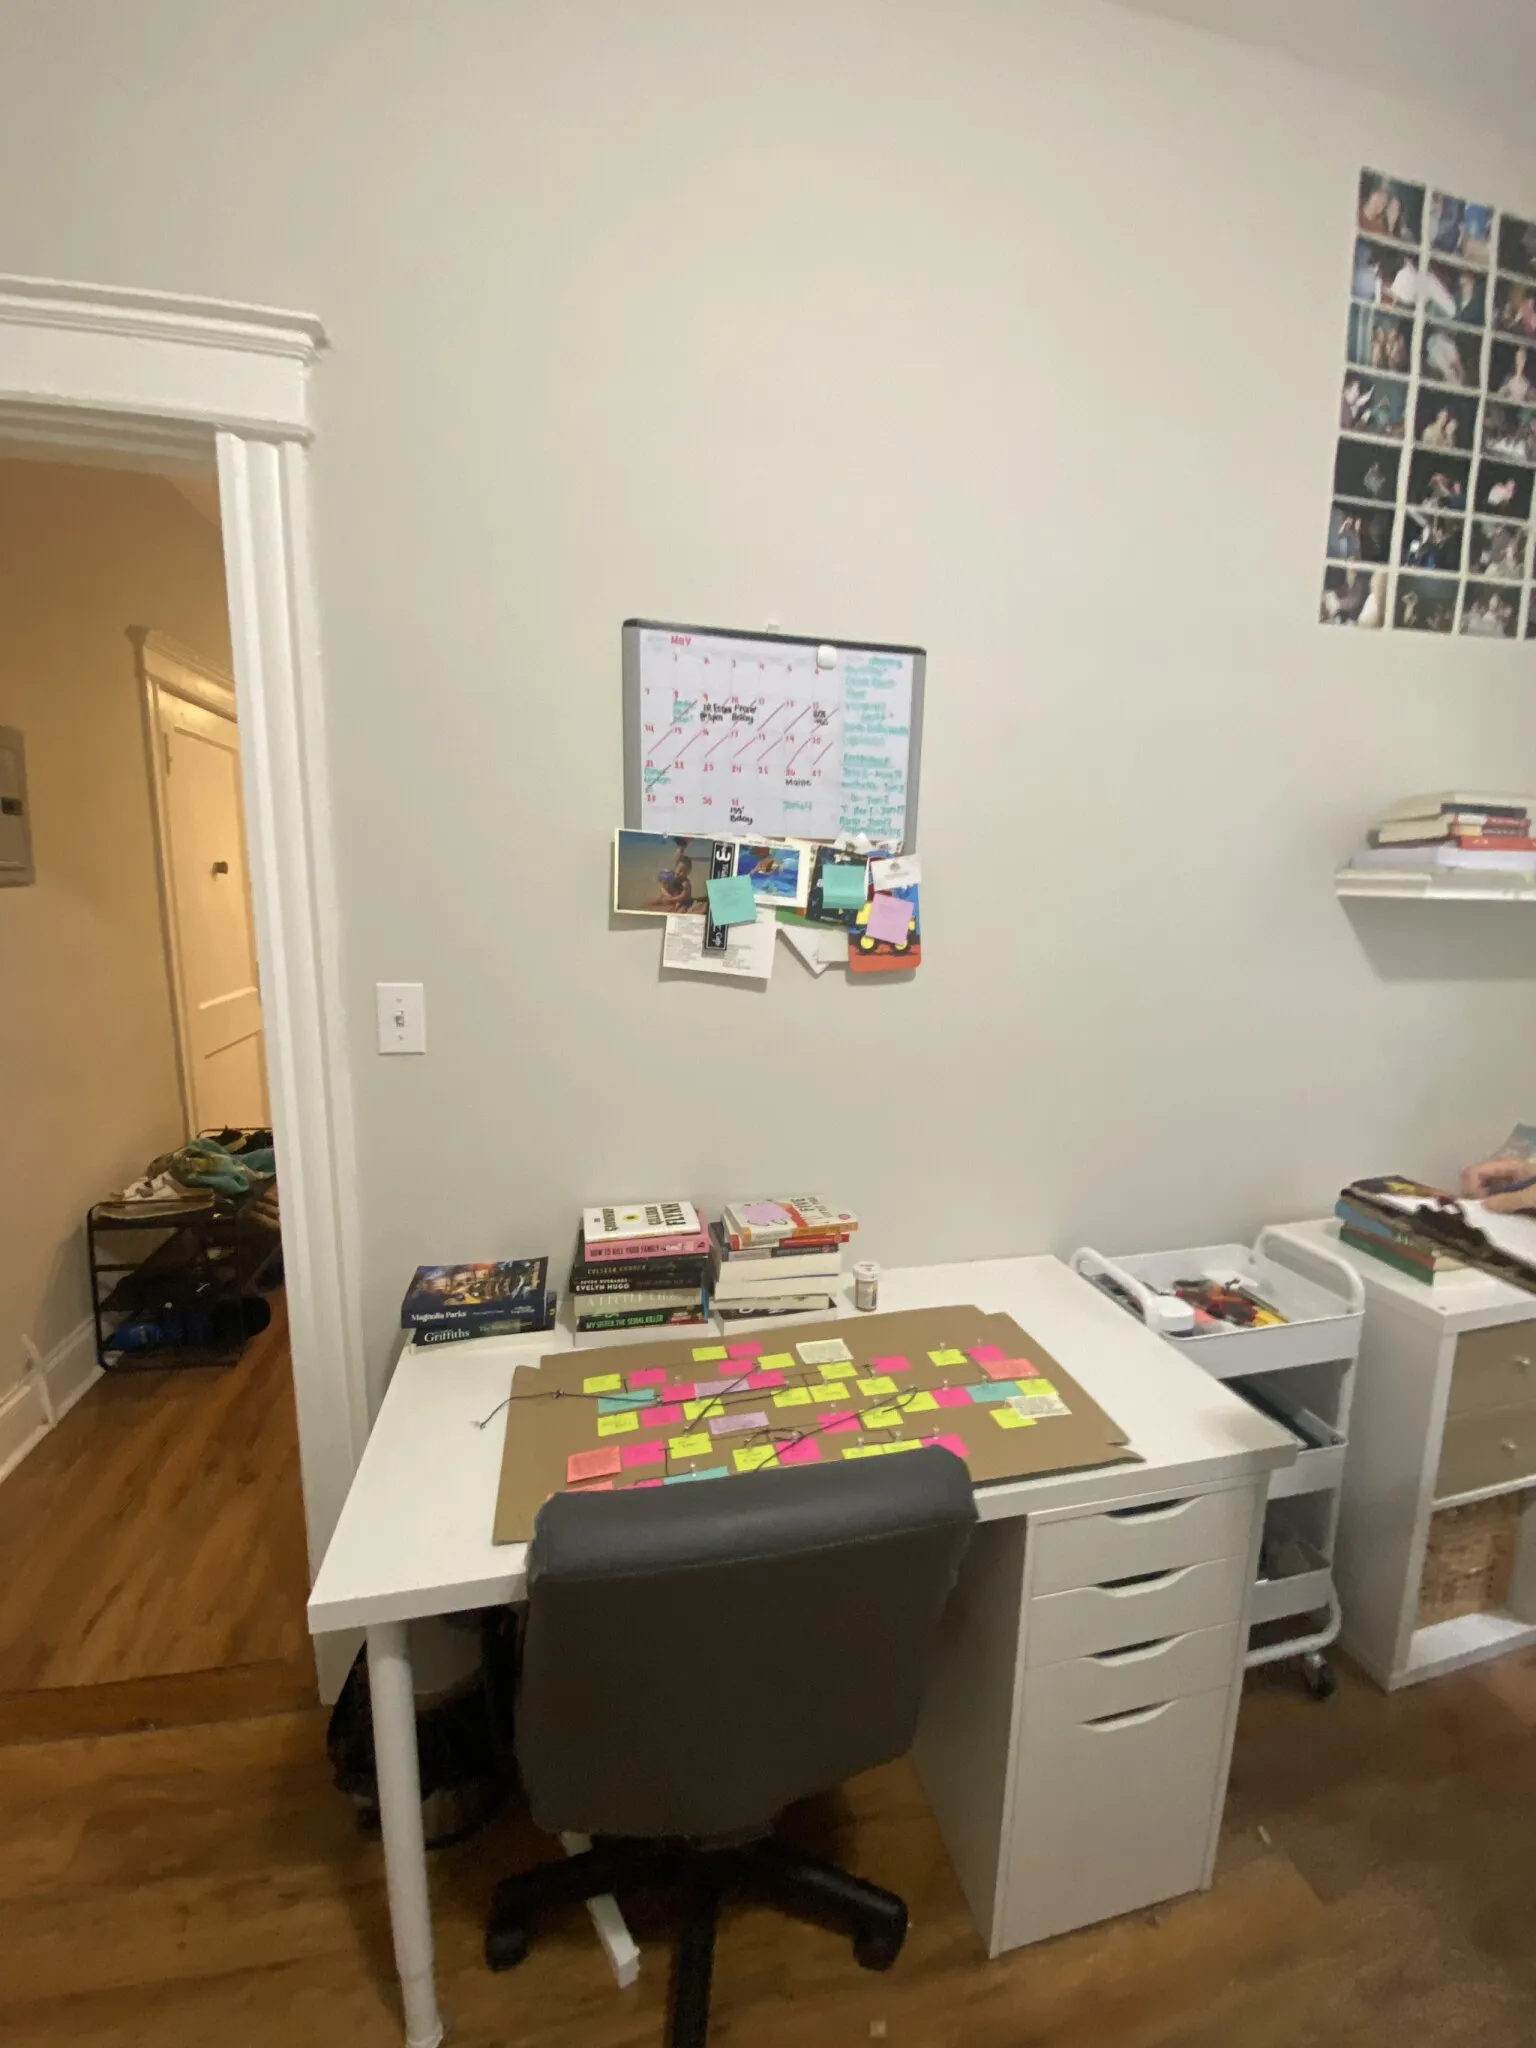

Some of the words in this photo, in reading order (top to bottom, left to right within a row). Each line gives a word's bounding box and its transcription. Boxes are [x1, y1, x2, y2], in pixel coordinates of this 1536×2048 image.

[785, 778, 812, 787] Maine
[576, 1284, 606, 1292] EVELYN
[607, 1282, 630, 1290] HUGO
[410, 1313, 445, 1323] Magnolia
[445, 1310, 467, 1320] Parks
[627, 1317, 645, 1325] SERIAL
[645, 1314, 664, 1323] KILLER
[423, 1327, 471, 1343] Griffiths
